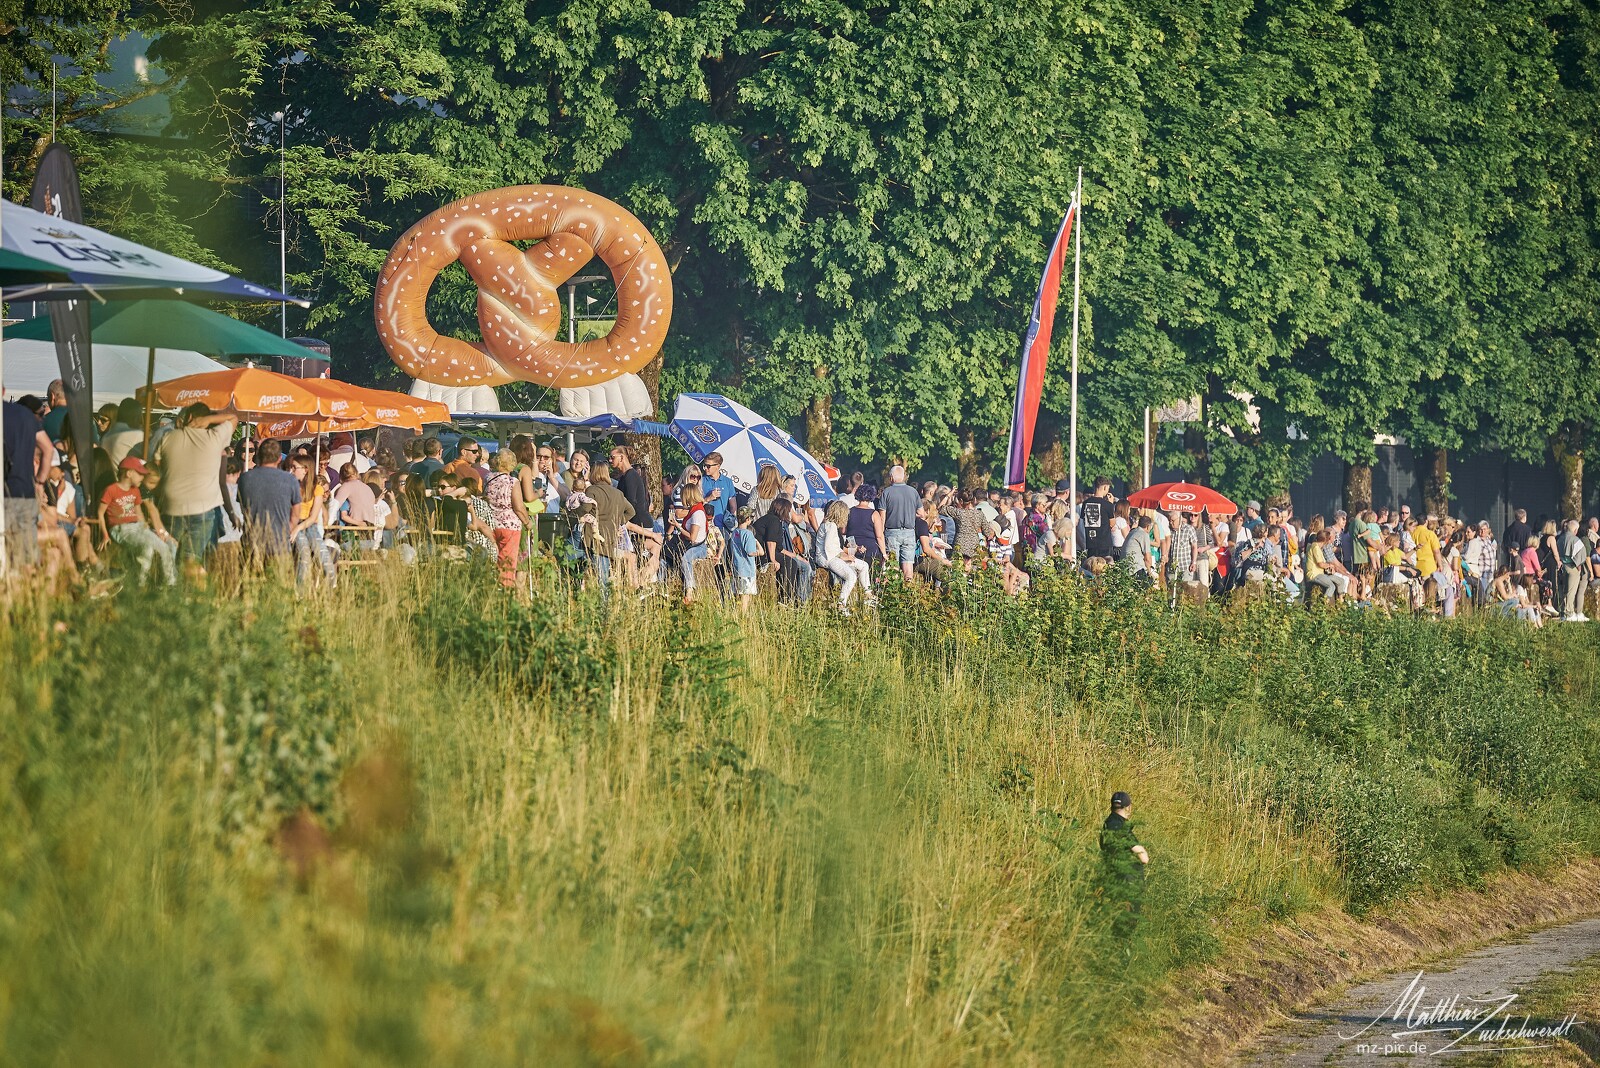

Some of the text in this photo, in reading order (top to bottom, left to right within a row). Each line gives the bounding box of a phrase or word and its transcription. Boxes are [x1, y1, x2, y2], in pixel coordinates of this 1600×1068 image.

[176, 389, 211, 402] APEROL
[258, 394, 295, 407] APEROL
[1168, 503, 1194, 511] ESKIMO
